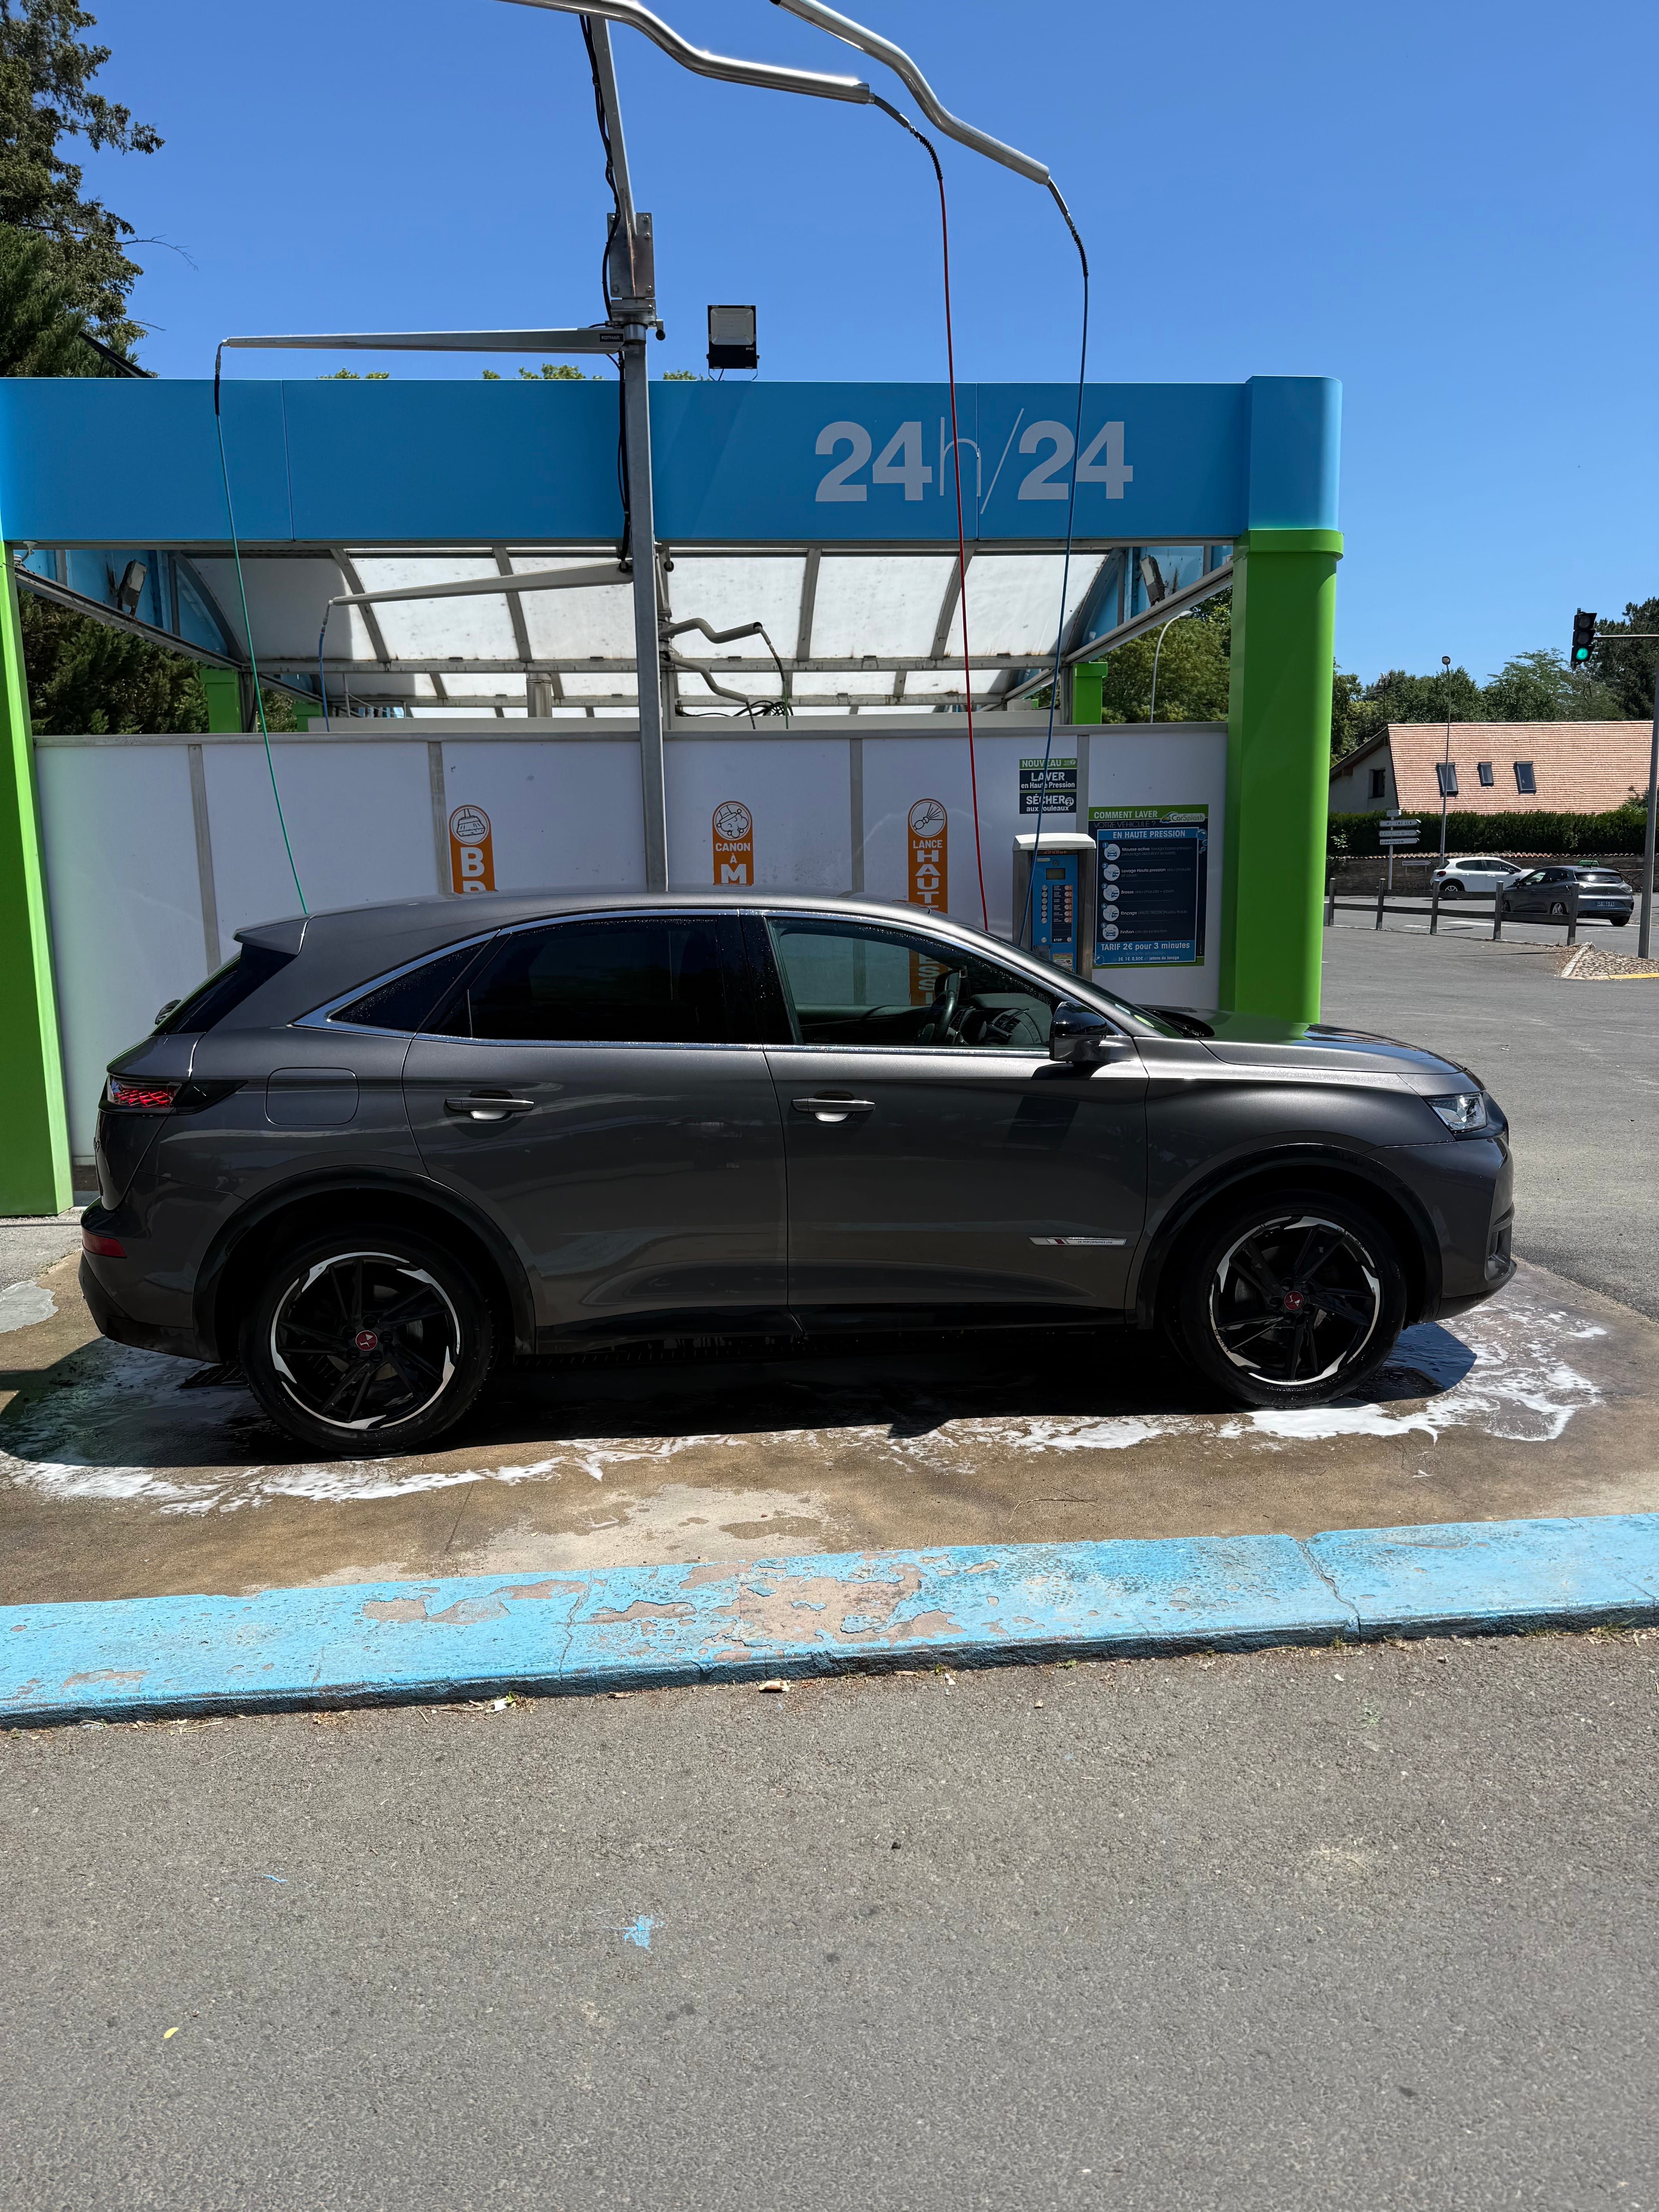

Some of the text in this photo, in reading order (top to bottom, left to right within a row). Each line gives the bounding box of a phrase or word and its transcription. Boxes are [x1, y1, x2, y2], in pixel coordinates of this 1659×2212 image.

[1031, 772, 1065, 781] LAVER
[715, 843, 750, 852] CANON
[913, 840, 943, 849] LANCE
[915, 850, 941, 909] HAUT
